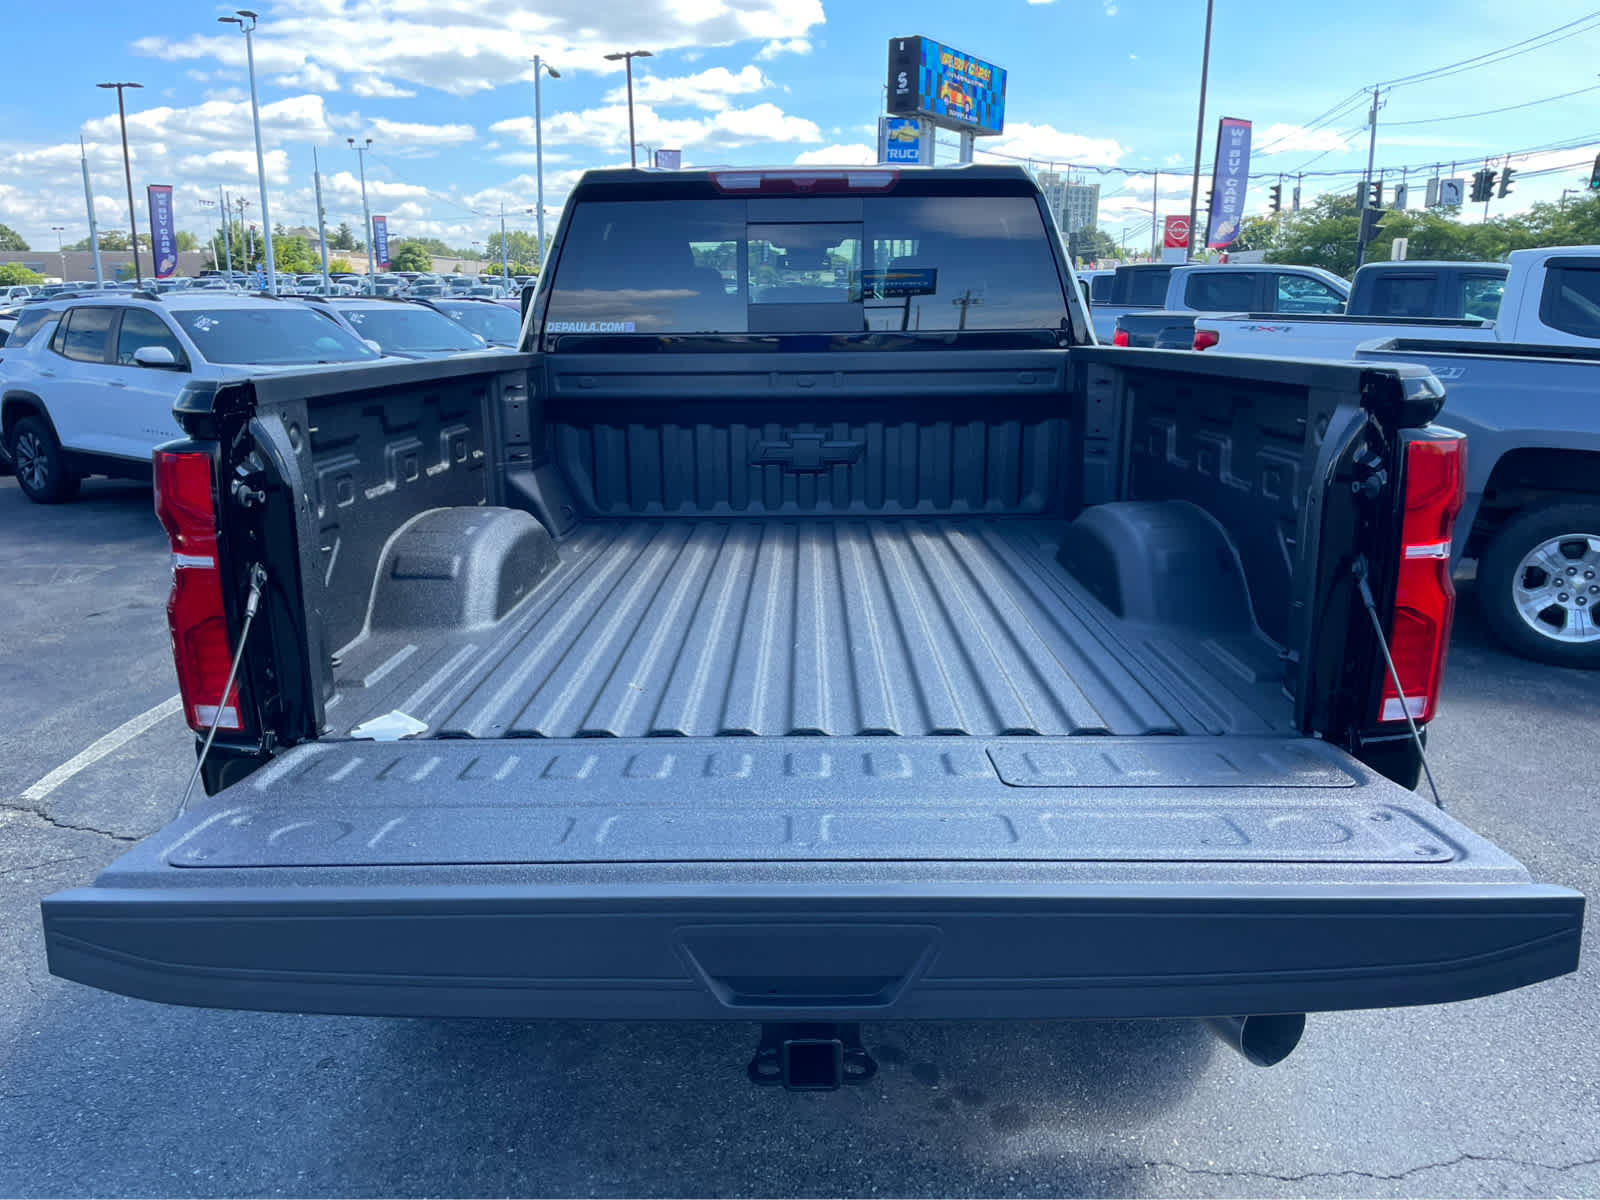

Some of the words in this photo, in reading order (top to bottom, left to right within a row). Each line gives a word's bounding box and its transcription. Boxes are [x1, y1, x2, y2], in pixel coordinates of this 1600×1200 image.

[1231, 128, 1244, 146] WE
[1228, 149, 1240, 175] BUY
[1223, 179, 1238, 213] CARS
